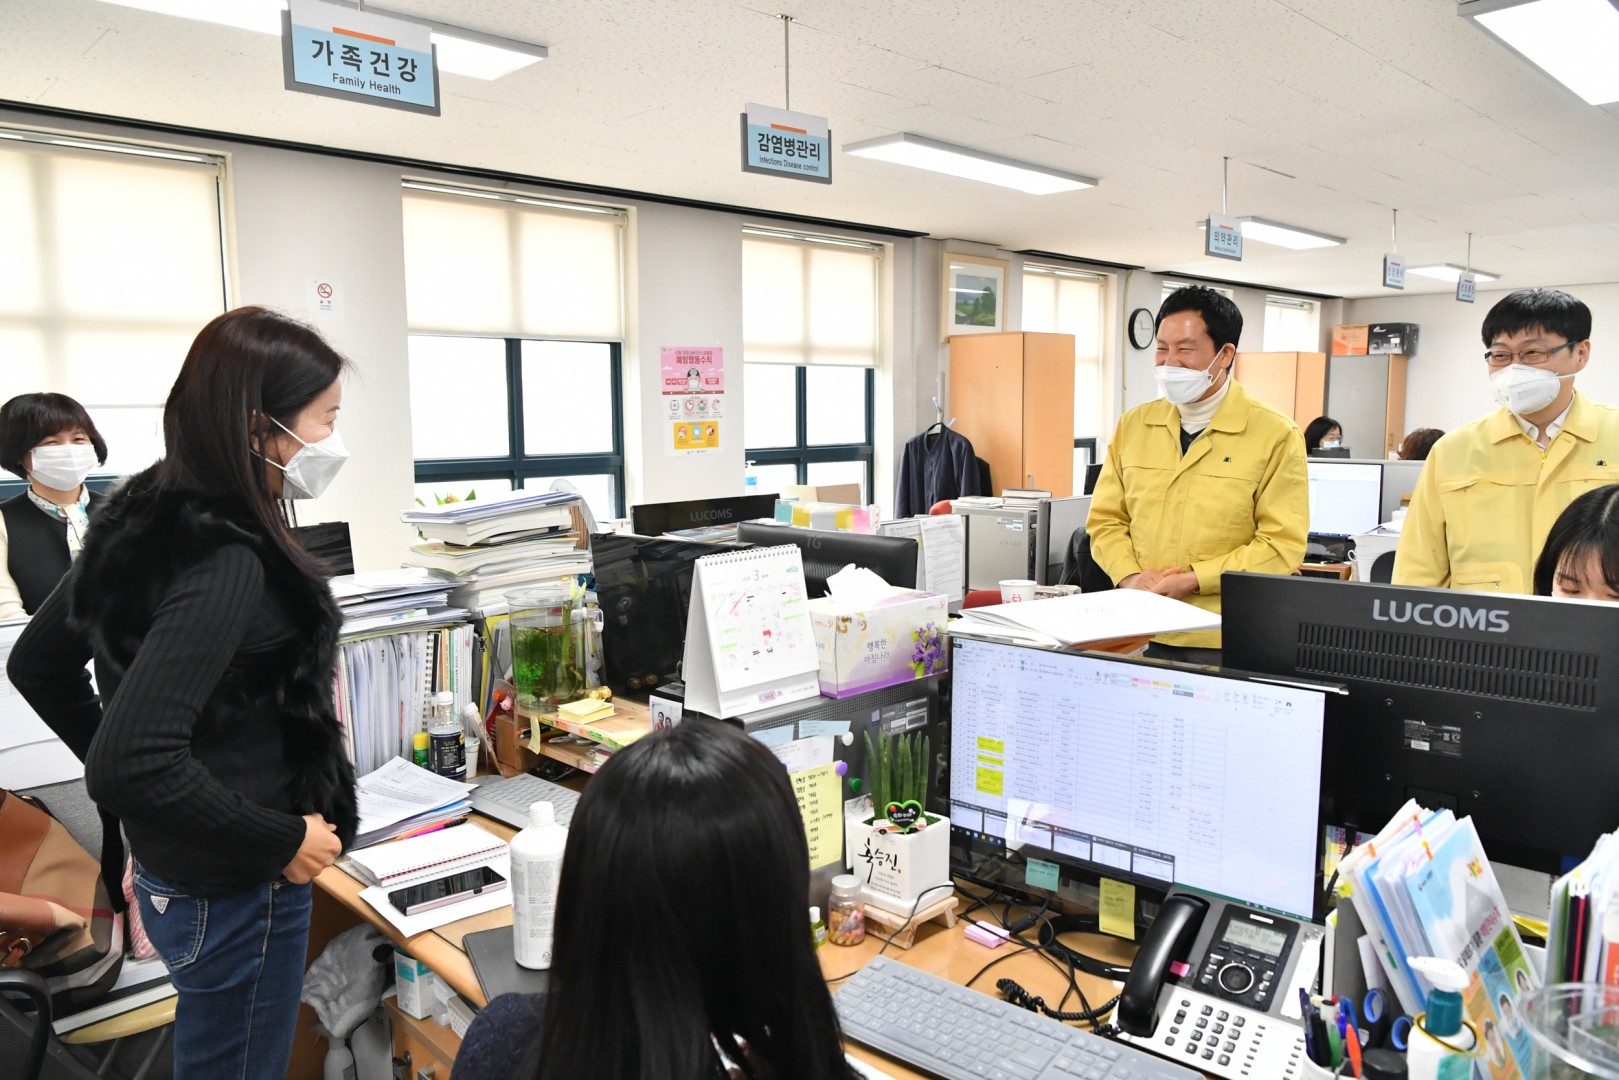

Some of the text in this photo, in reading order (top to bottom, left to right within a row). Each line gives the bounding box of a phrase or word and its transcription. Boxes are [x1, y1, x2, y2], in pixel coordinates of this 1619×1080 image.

[311, 39, 418, 83] 가족건강
[332, 73, 401, 95] Family Health
[757, 132, 820, 162] 감염병관리
[783, 159, 802, 170] Disease
[690, 508, 733, 521] LUCOMS
[754, 569, 760, 581] 3
[1372, 599, 1510, 633] LUCOMS
[867, 639, 888, 653] 행복한
[863, 651, 891, 664] 아침나라
